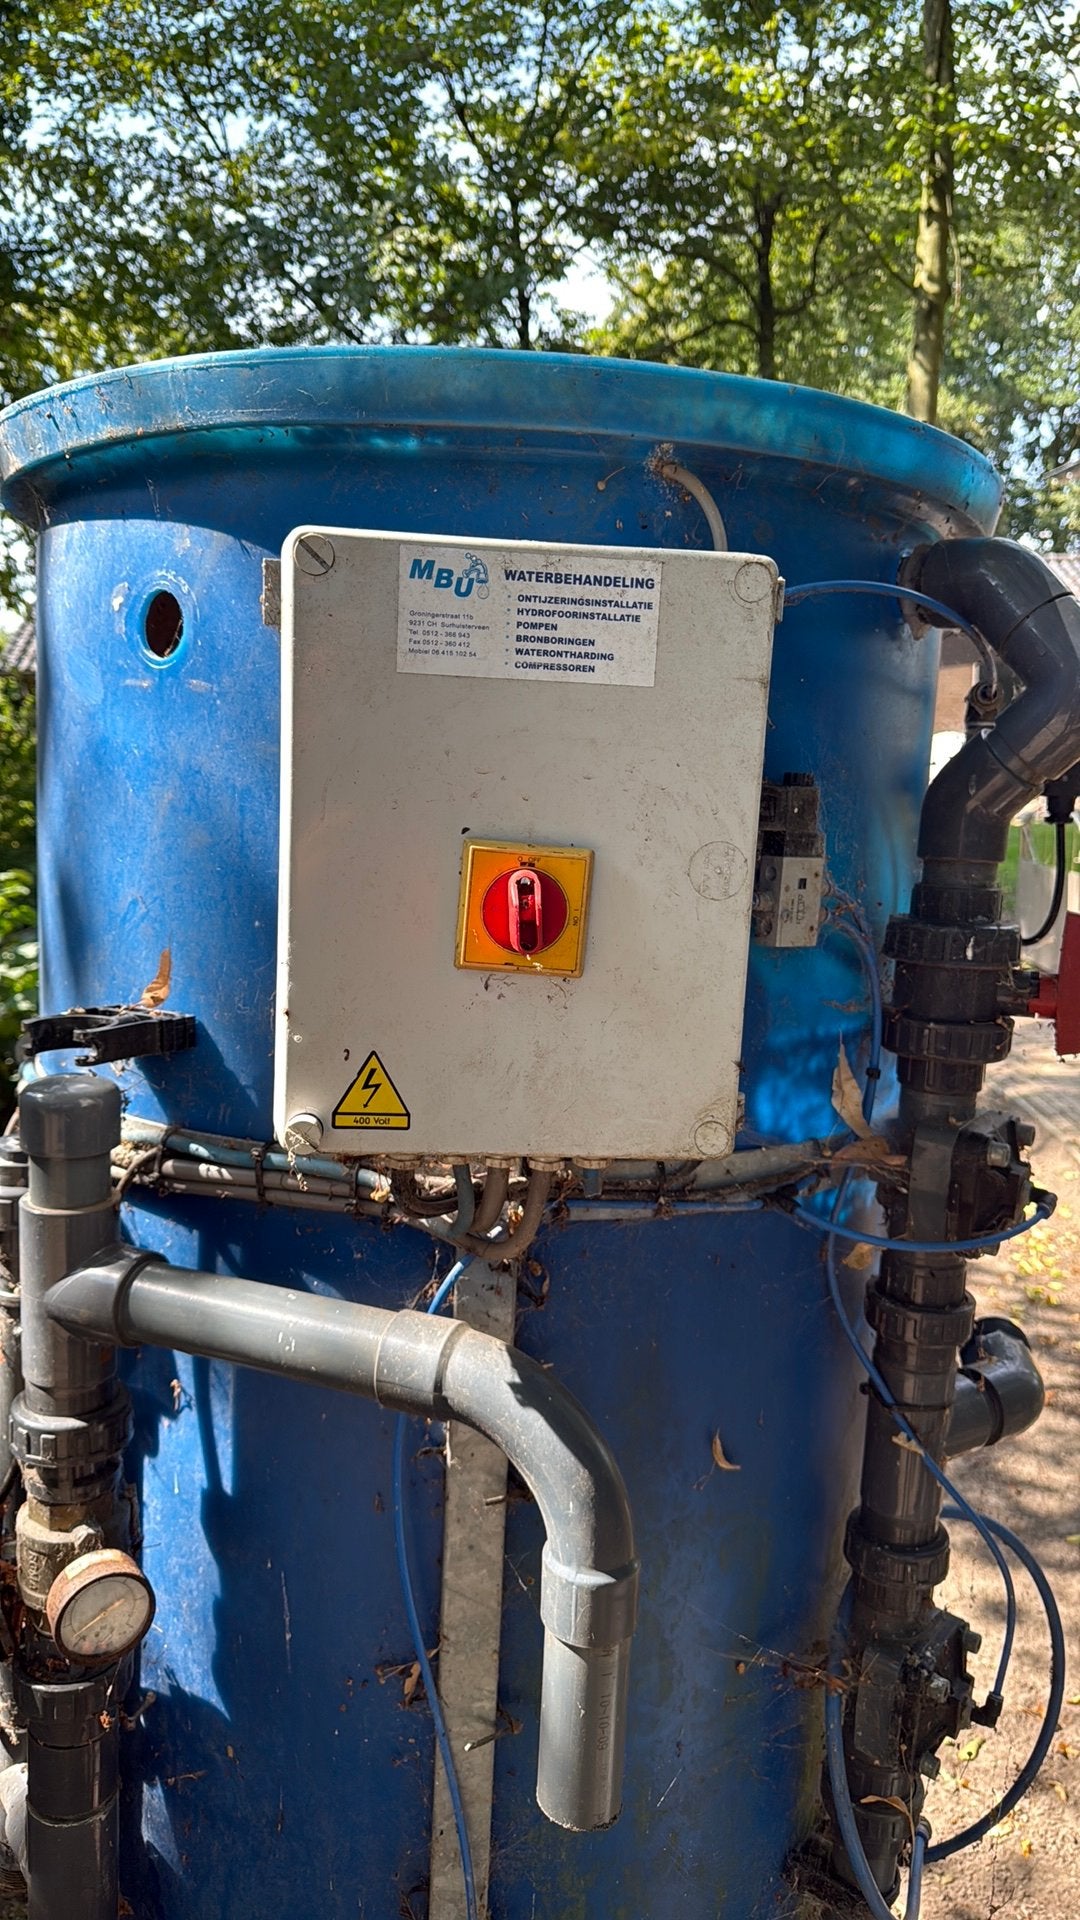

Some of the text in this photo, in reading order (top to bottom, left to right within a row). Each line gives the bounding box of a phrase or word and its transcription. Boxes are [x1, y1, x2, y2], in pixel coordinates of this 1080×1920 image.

[409, 559, 475, 598] MBU
[504, 569, 655, 589] WATERBEHANDELING
[517, 594, 653, 610] ONTIJZERINGSINSTALLATIE
[409, 610, 461, 619] Groningerstraat
[517, 608, 641, 622] HYDROFOORINSTALLATIE
[408, 619, 425, 627] 9231
[440, 622, 490, 631] Surhuisterveen
[516, 621, 558, 631] POMPEN
[516, 634, 595, 646] BRONBORINGEN
[515, 647, 615, 661] WATERONTHARDING
[514, 661, 595, 673] COMPRESSOREN
[353, 1116, 391, 1125] 400 Volt
